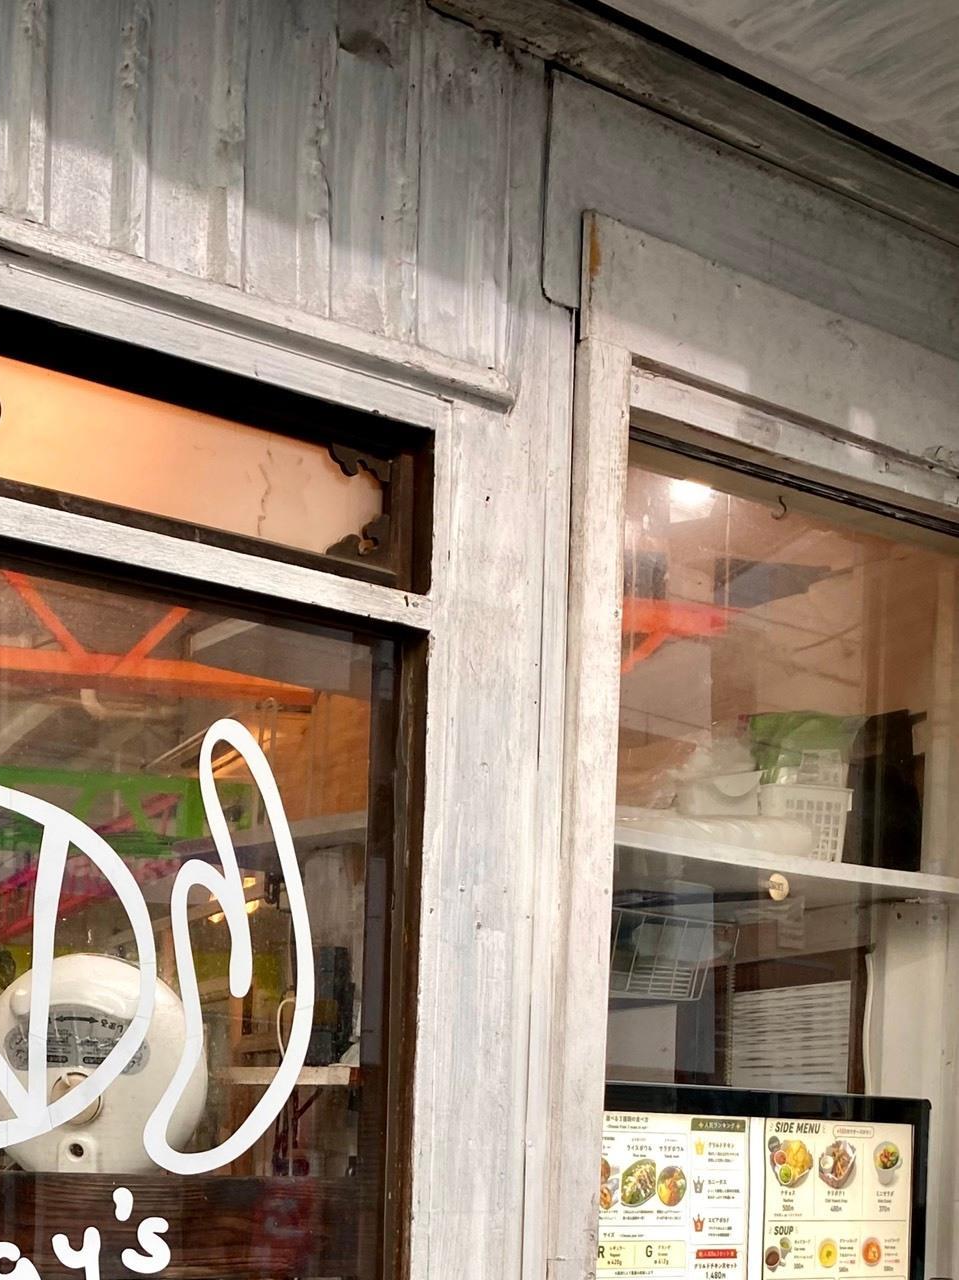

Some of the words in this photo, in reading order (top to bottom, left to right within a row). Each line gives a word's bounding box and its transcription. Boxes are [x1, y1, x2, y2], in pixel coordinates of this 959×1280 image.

[774, 1122, 794, 1134] SIDE
[796, 1122, 821, 1135] MENU
[774, 1225, 794, 1236] SOUP
[597, 1245, 605, 1258] R
[645, 1245, 653, 1258] G
